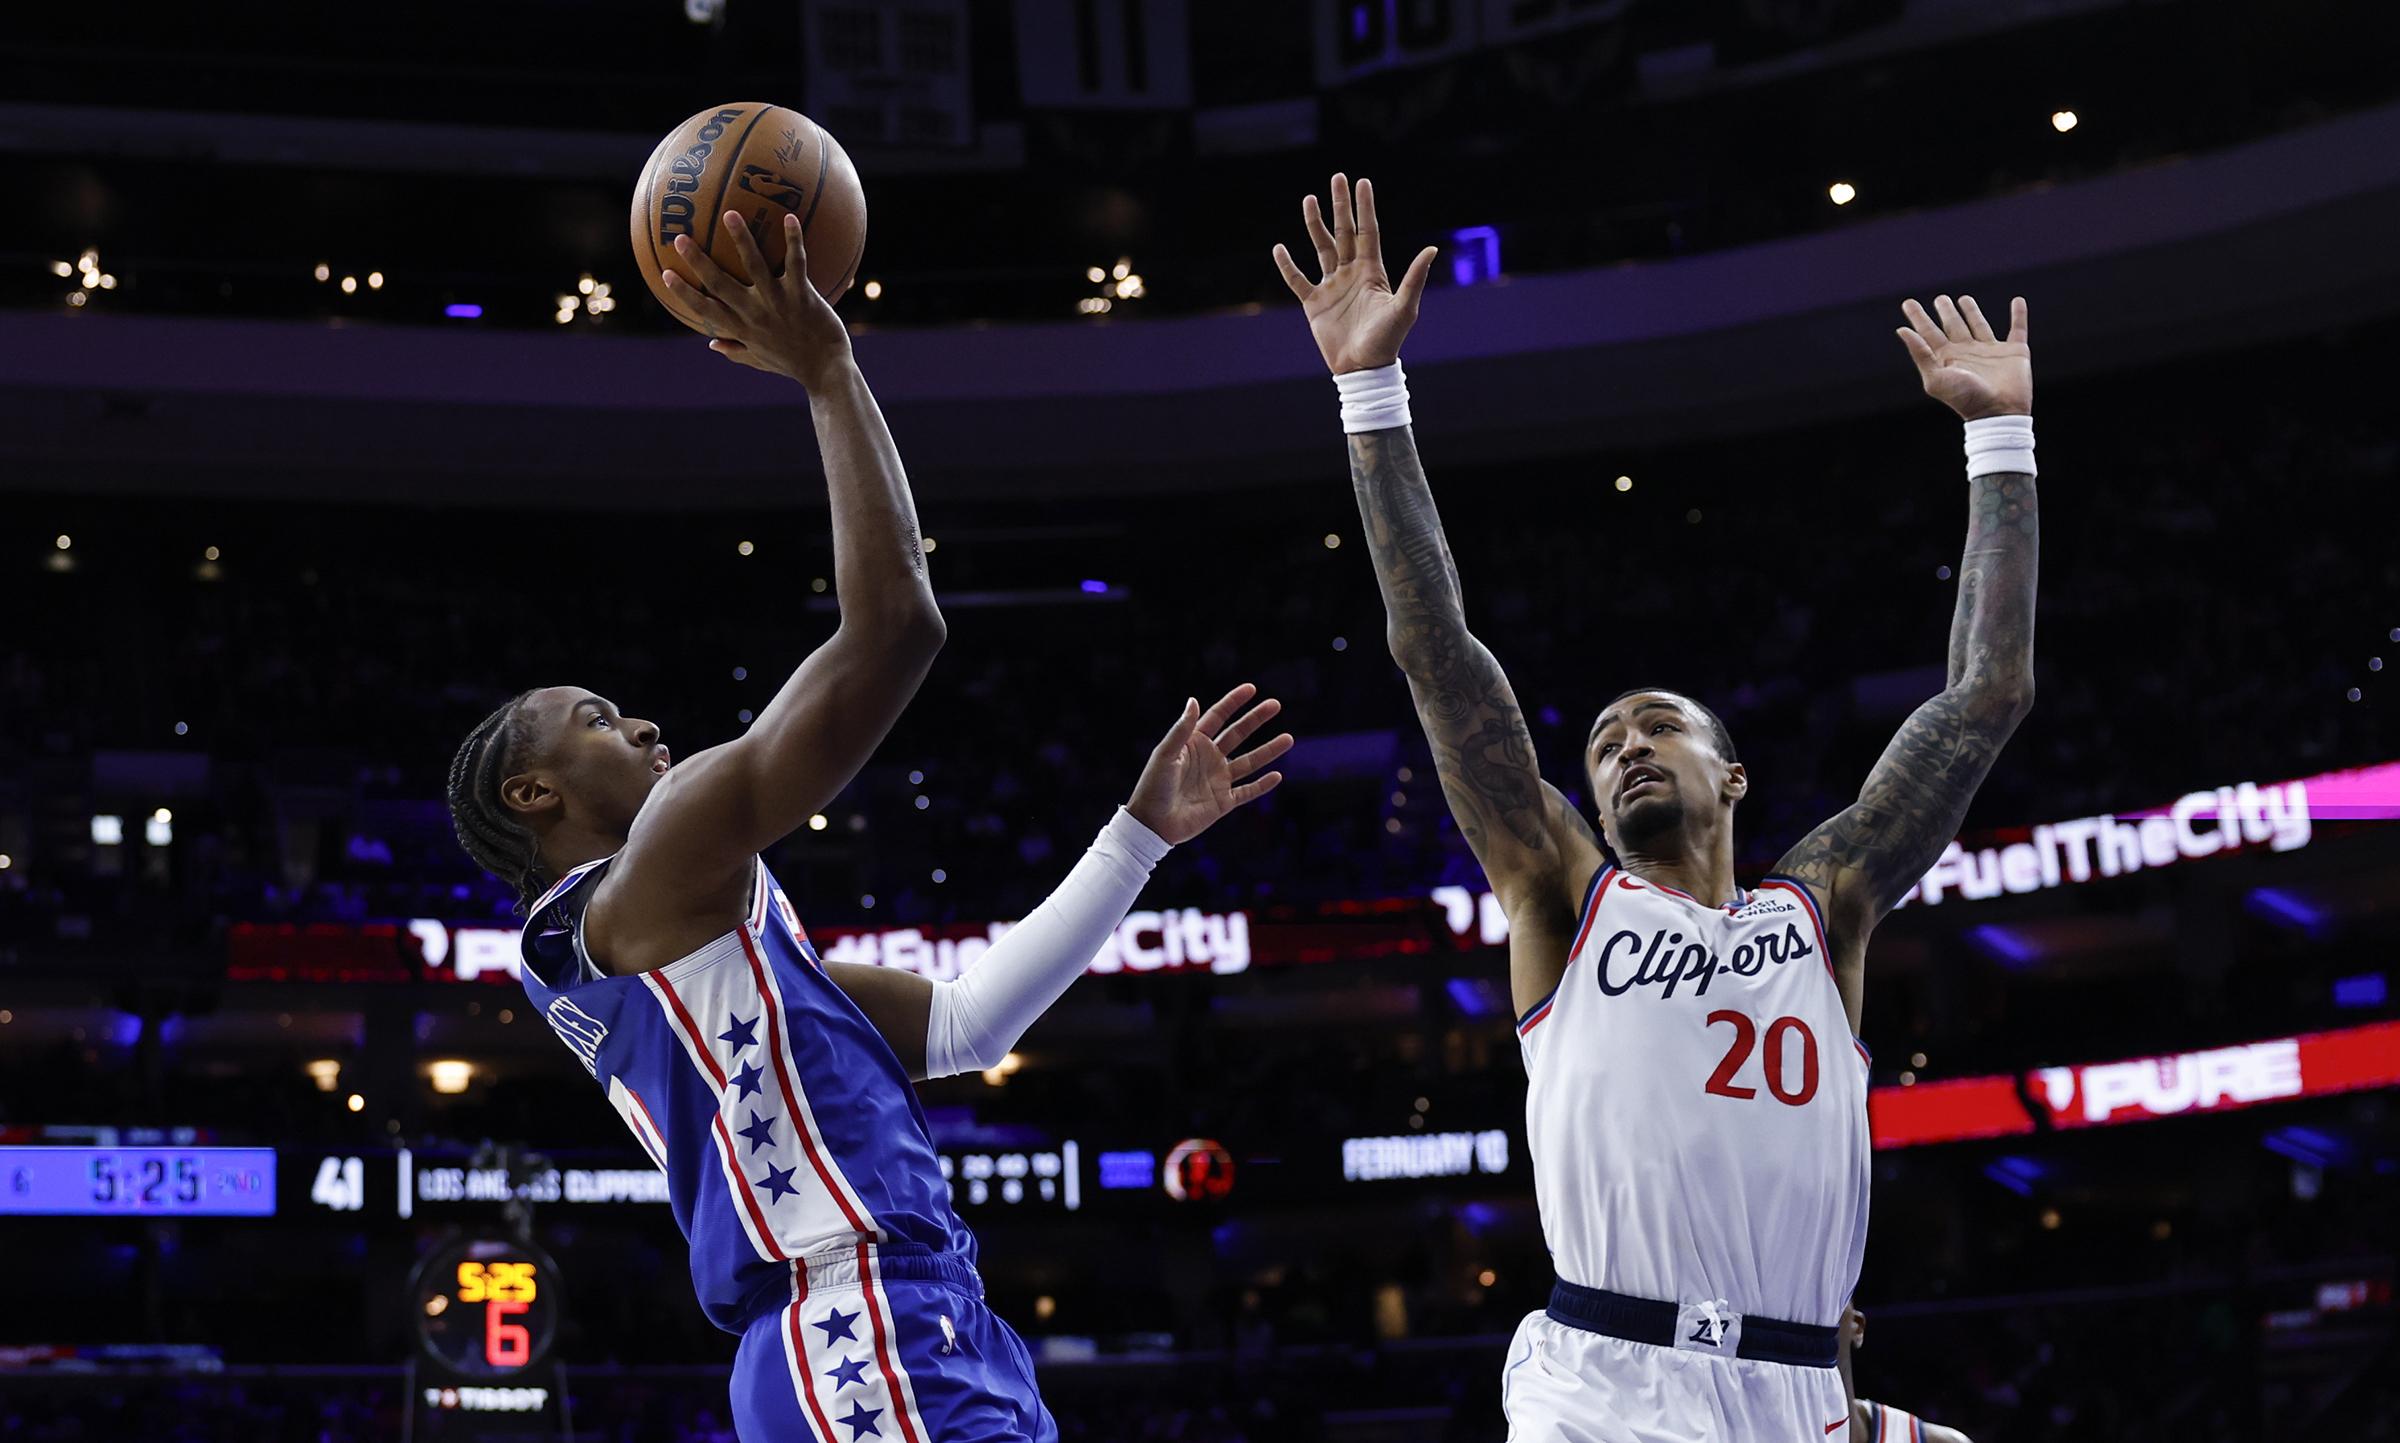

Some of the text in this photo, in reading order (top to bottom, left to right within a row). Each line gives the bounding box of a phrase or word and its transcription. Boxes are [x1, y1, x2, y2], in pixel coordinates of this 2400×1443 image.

[660, 109, 746, 246] Wilson
[1599, 923, 1812, 999] Clippers
[1705, 1010, 1819, 1106] 20
[2083, 1038, 2302, 1121] PURE
[93, 1157, 199, 1202] 5:25
[311, 1156, 363, 1211] 41
[419, 1168, 464, 1200] LOS
[457, 1262, 536, 1302] 5:25
[485, 1302, 530, 1366] 6
